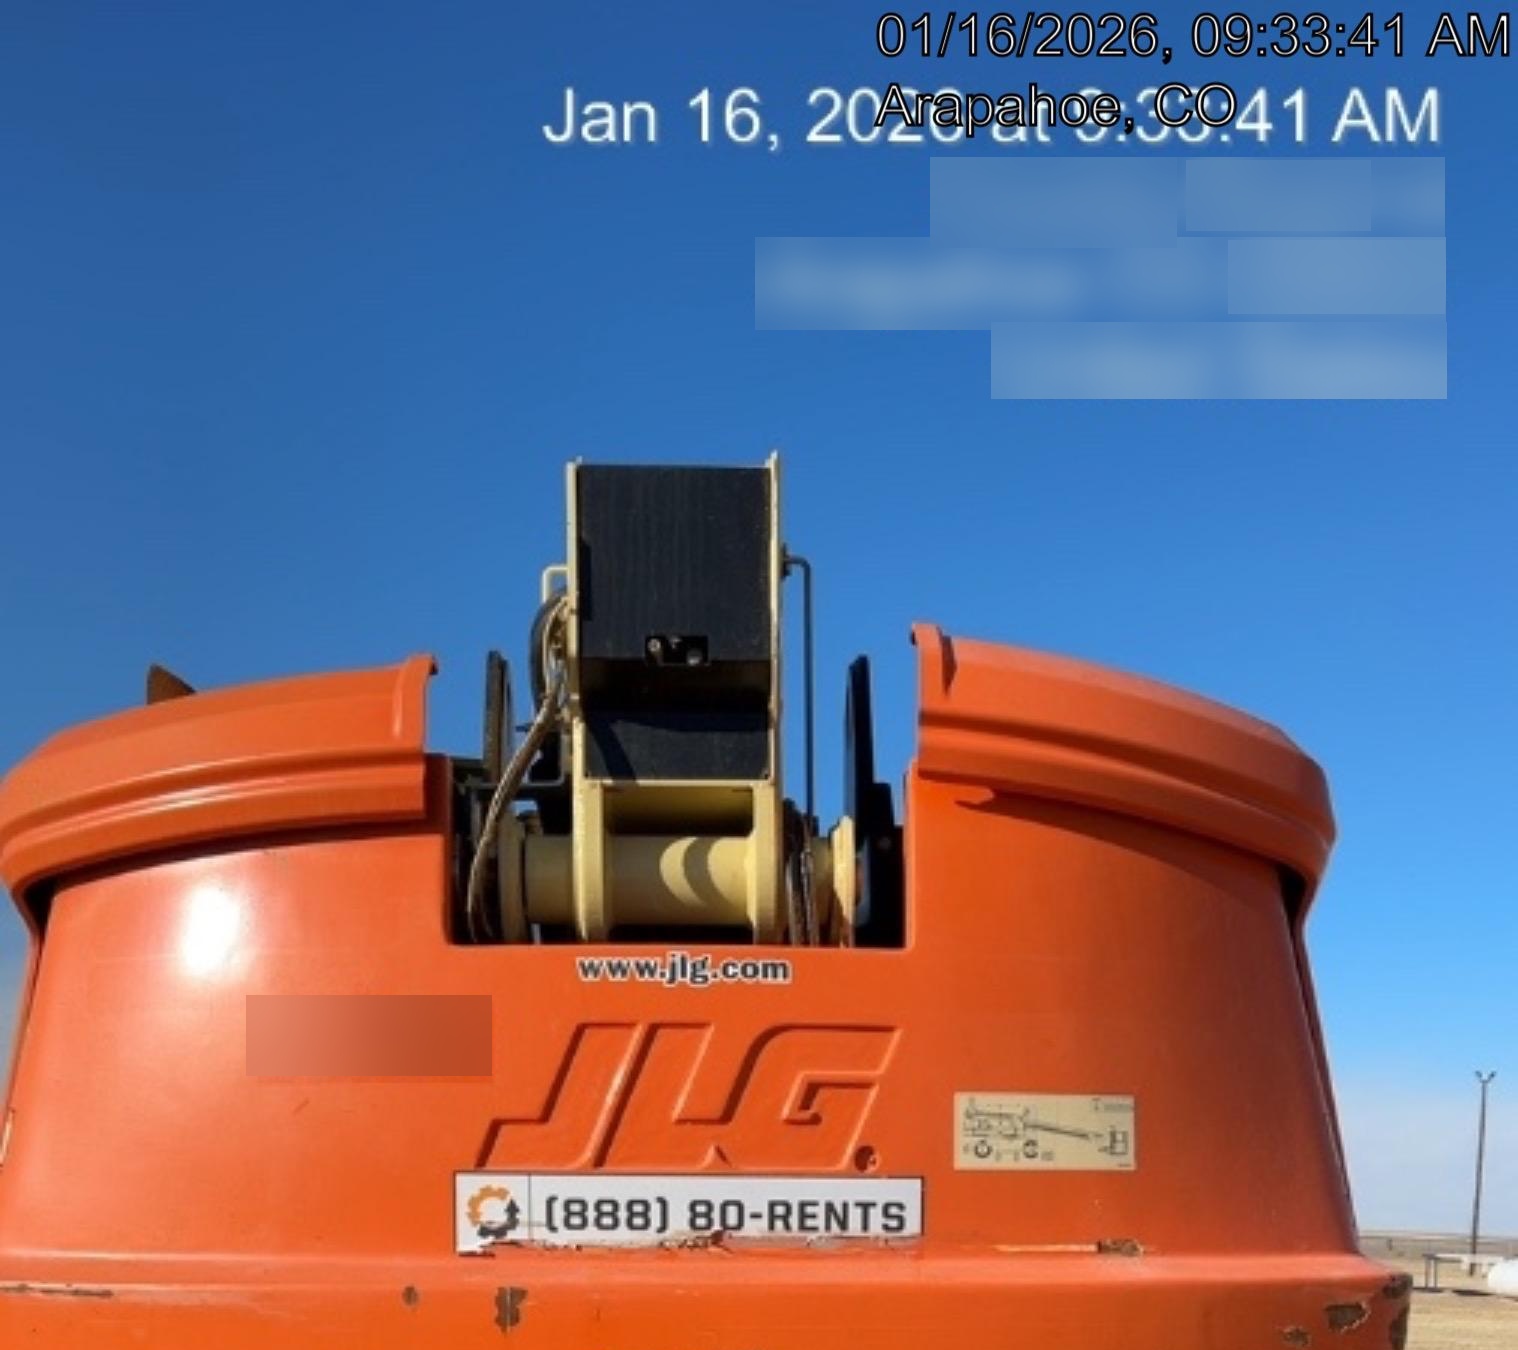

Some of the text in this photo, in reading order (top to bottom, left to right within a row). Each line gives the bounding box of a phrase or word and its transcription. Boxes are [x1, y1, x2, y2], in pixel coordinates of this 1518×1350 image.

[575, 953, 792, 986] www.jlg.com
[544, 1196, 908, 1235] (888) 80-RENTS
